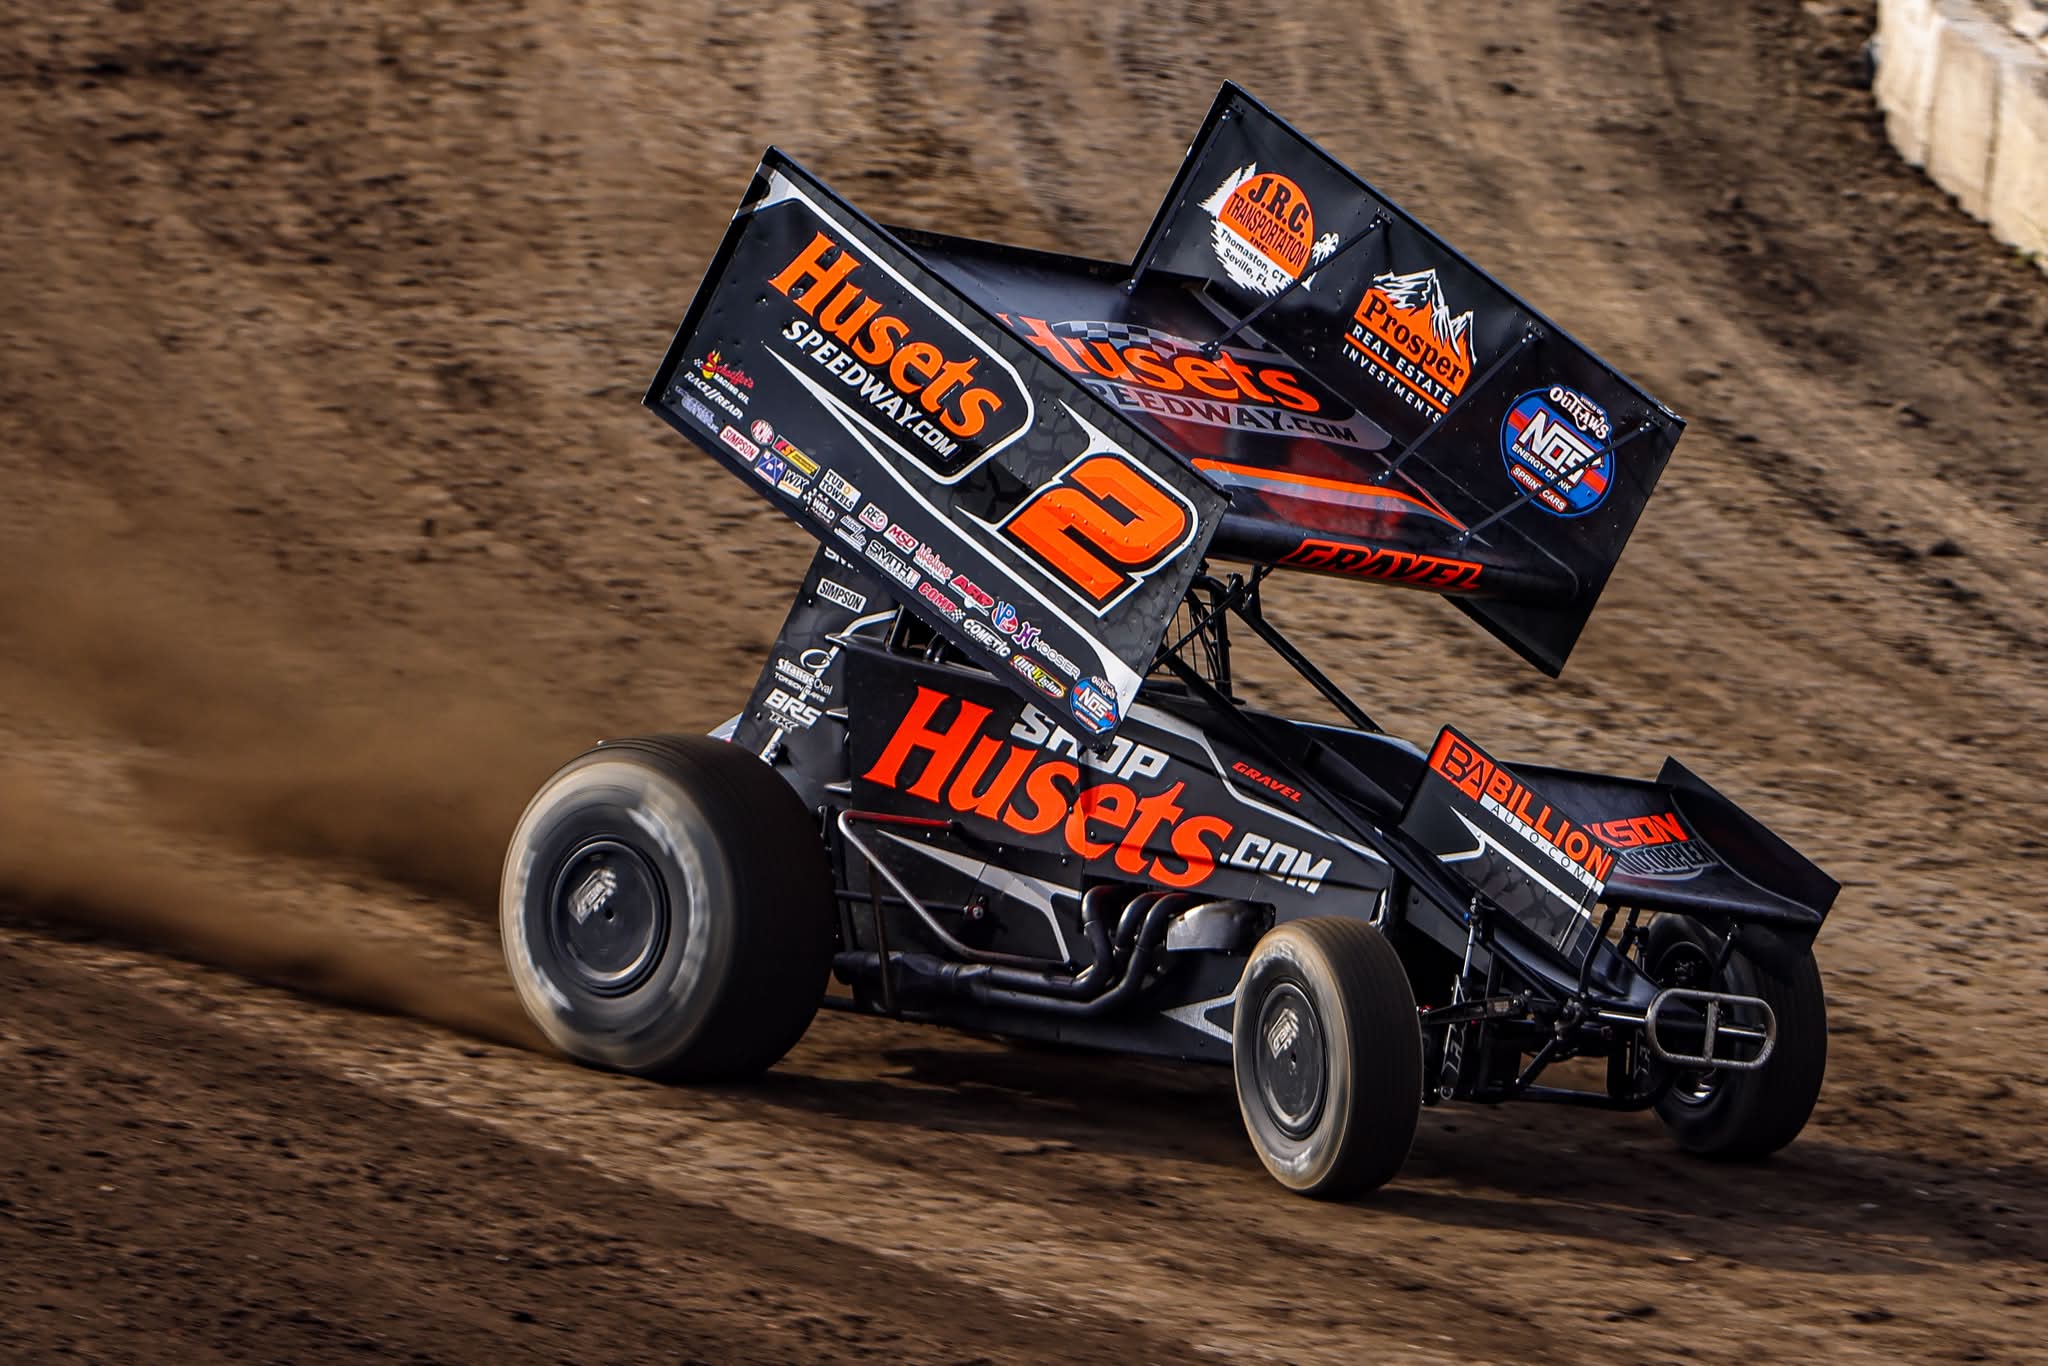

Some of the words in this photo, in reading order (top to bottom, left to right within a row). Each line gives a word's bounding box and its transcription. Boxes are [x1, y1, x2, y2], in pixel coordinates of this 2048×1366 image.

[1248, 177, 1309, 238] J.R.C.
[1227, 193, 1308, 267] TRANSPORTATION
[1221, 229, 1269, 274] Thomaston,
[1272, 268, 1286, 283] CT
[1224, 248, 1253, 279] Seville,
[1256, 275, 1267, 287] FL
[768, 231, 1003, 439] Husets
[1361, 294, 1464, 384] Prosper
[713, 373, 739, 396] RACING
[1342, 344, 1442, 423] INVESTMENTS
[1352, 325, 1390, 361] REAL
[1395, 357, 1452, 406] ESTATE
[782, 321, 958, 460] SPEEDWAY.COM
[722, 429, 757, 460] SIMPSON
[1518, 409, 1604, 485] NOS
[785, 471, 807, 492] WIX
[825, 471, 844, 488] TUB
[1512, 443, 1546, 473] ENERGY
[1544, 469, 1572, 493] DRNK
[812, 498, 836, 519] WELD
[821, 481, 854, 510] TOWELS
[1542, 489, 1567, 511] CARS
[889, 526, 916, 548] MSD
[1007, 458, 1187, 600] 2
[819, 580, 862, 610] SIMPSON
[919, 583, 958, 612] COMP
[952, 575, 993, 607] ARP
[963, 620, 1010, 656] COMETIC
[1032, 637, 1080, 679] HOOSIER
[763, 688, 822, 727] BRS
[1079, 687, 1112, 718] NOS
[1231, 761, 1302, 803] GRAVEL
